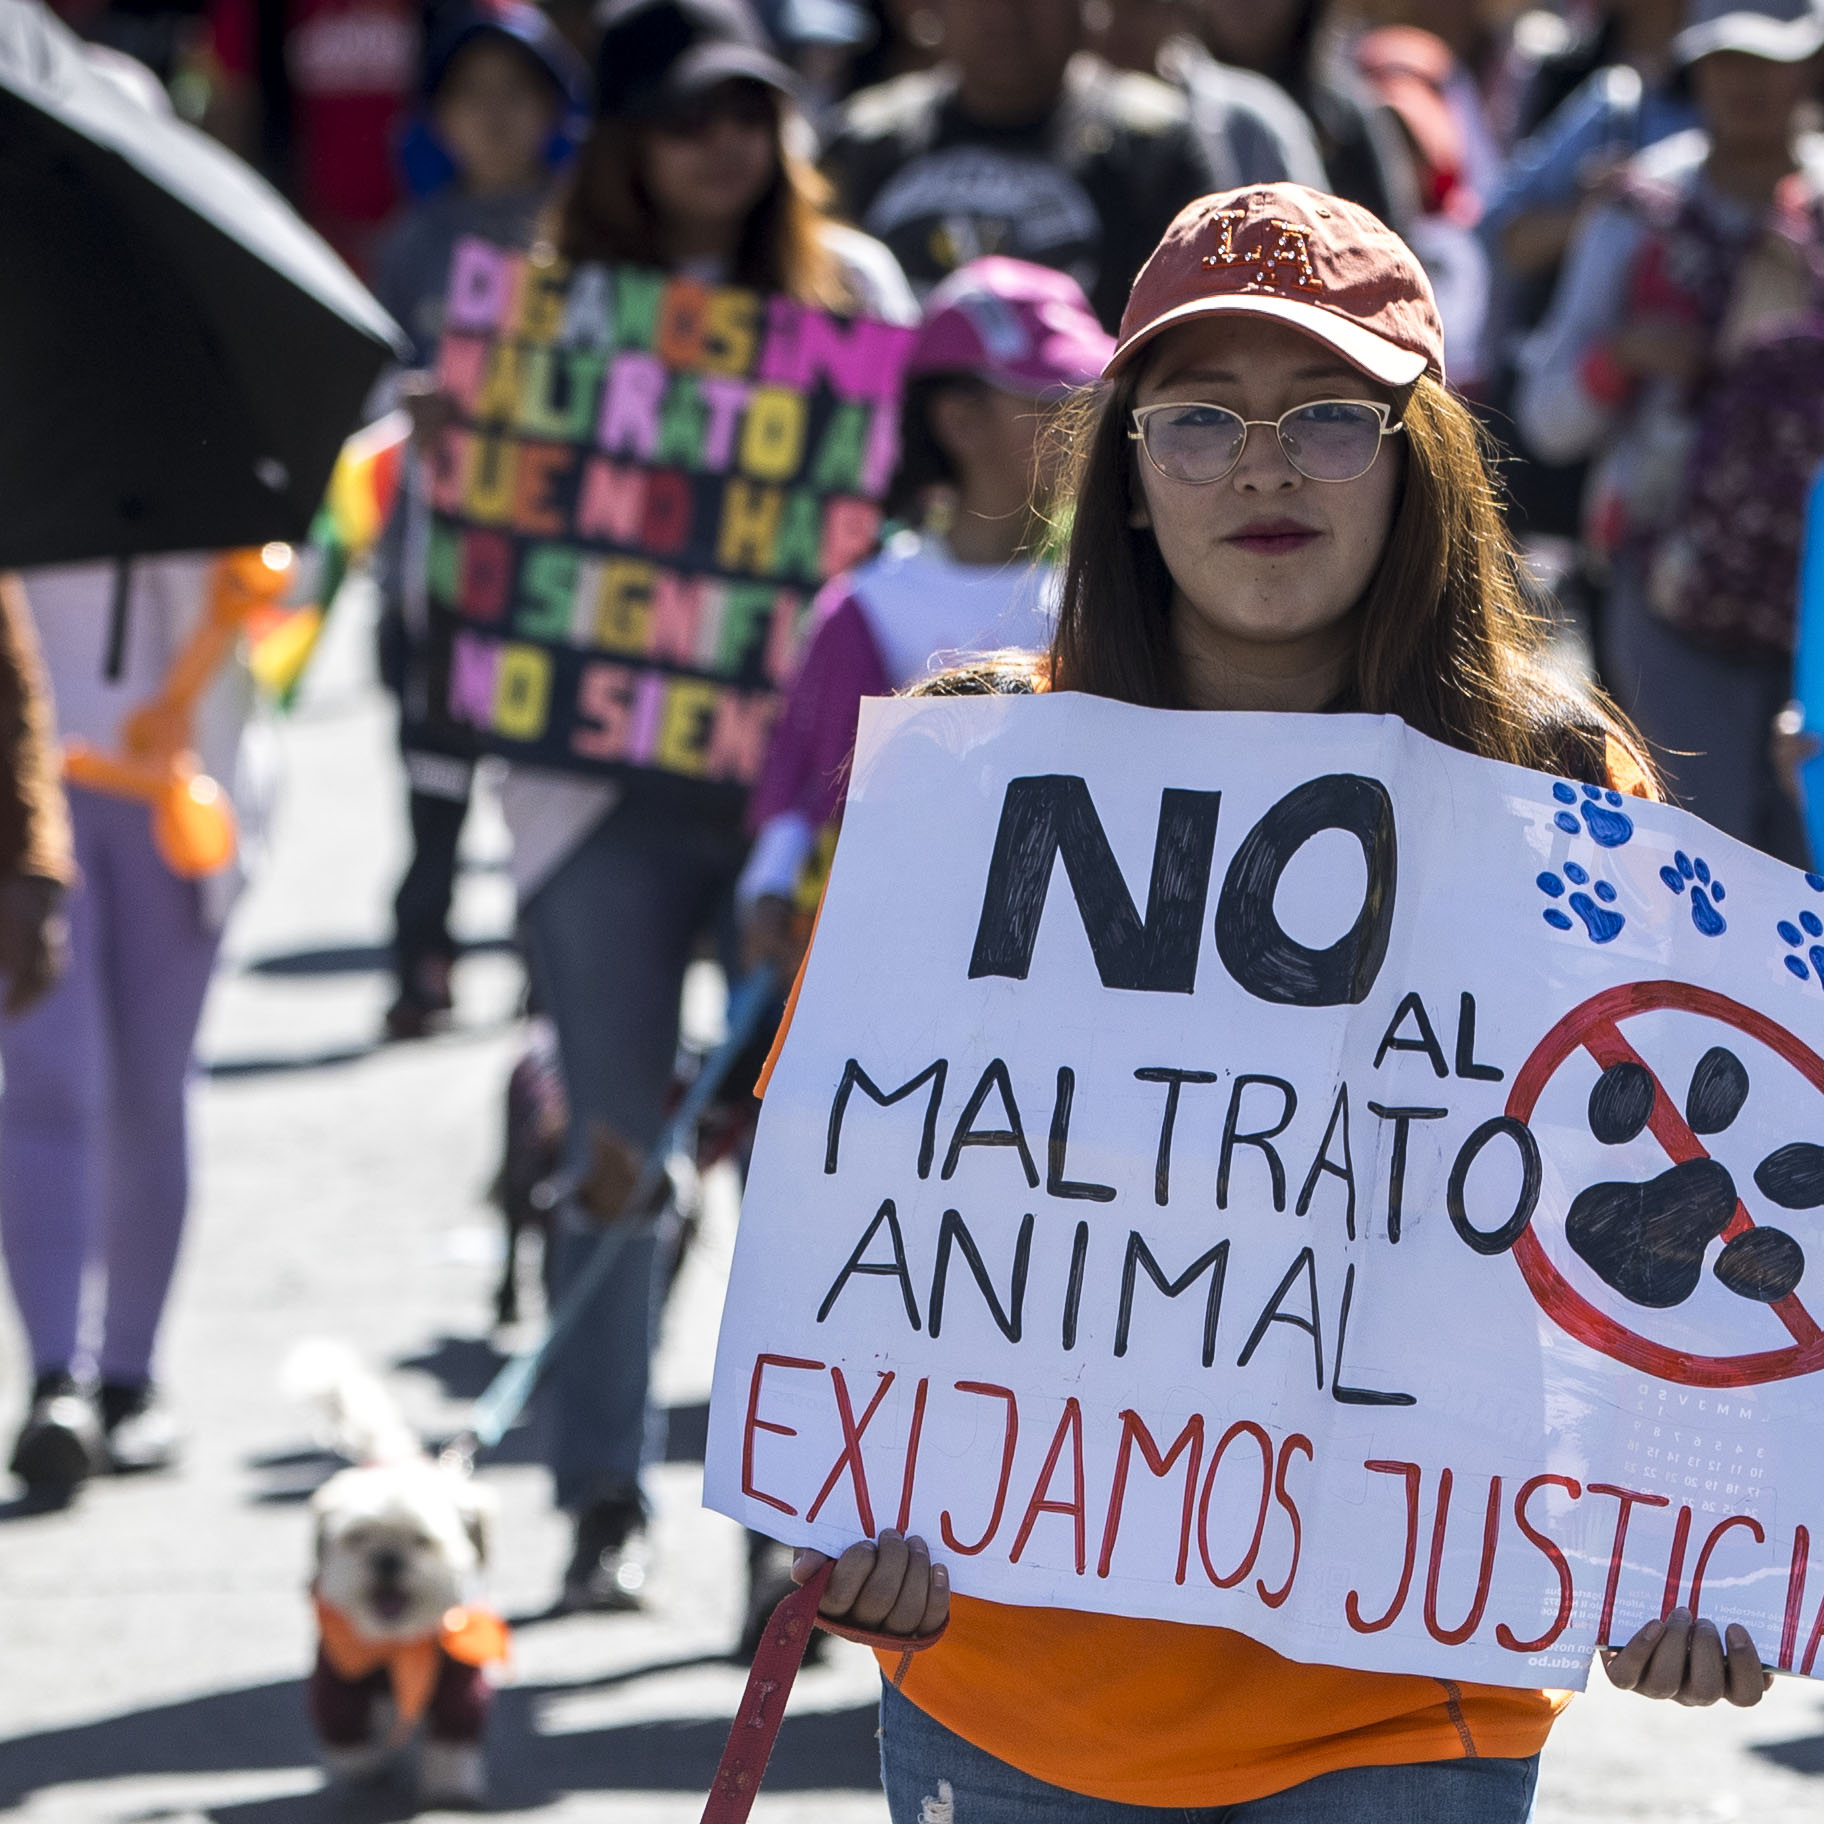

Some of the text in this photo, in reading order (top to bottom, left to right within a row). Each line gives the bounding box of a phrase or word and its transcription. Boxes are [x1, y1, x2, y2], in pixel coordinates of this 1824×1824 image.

[1202, 209, 1323, 294] LA
[968, 773, 1399, 1006] NO
[1373, 992, 1505, 1083] AL
[824, 1057, 1544, 1256] MALTRATO
[816, 1198, 1417, 1407] ANIMAL
[741, 1352, 1316, 1609] EXIJAMOS
